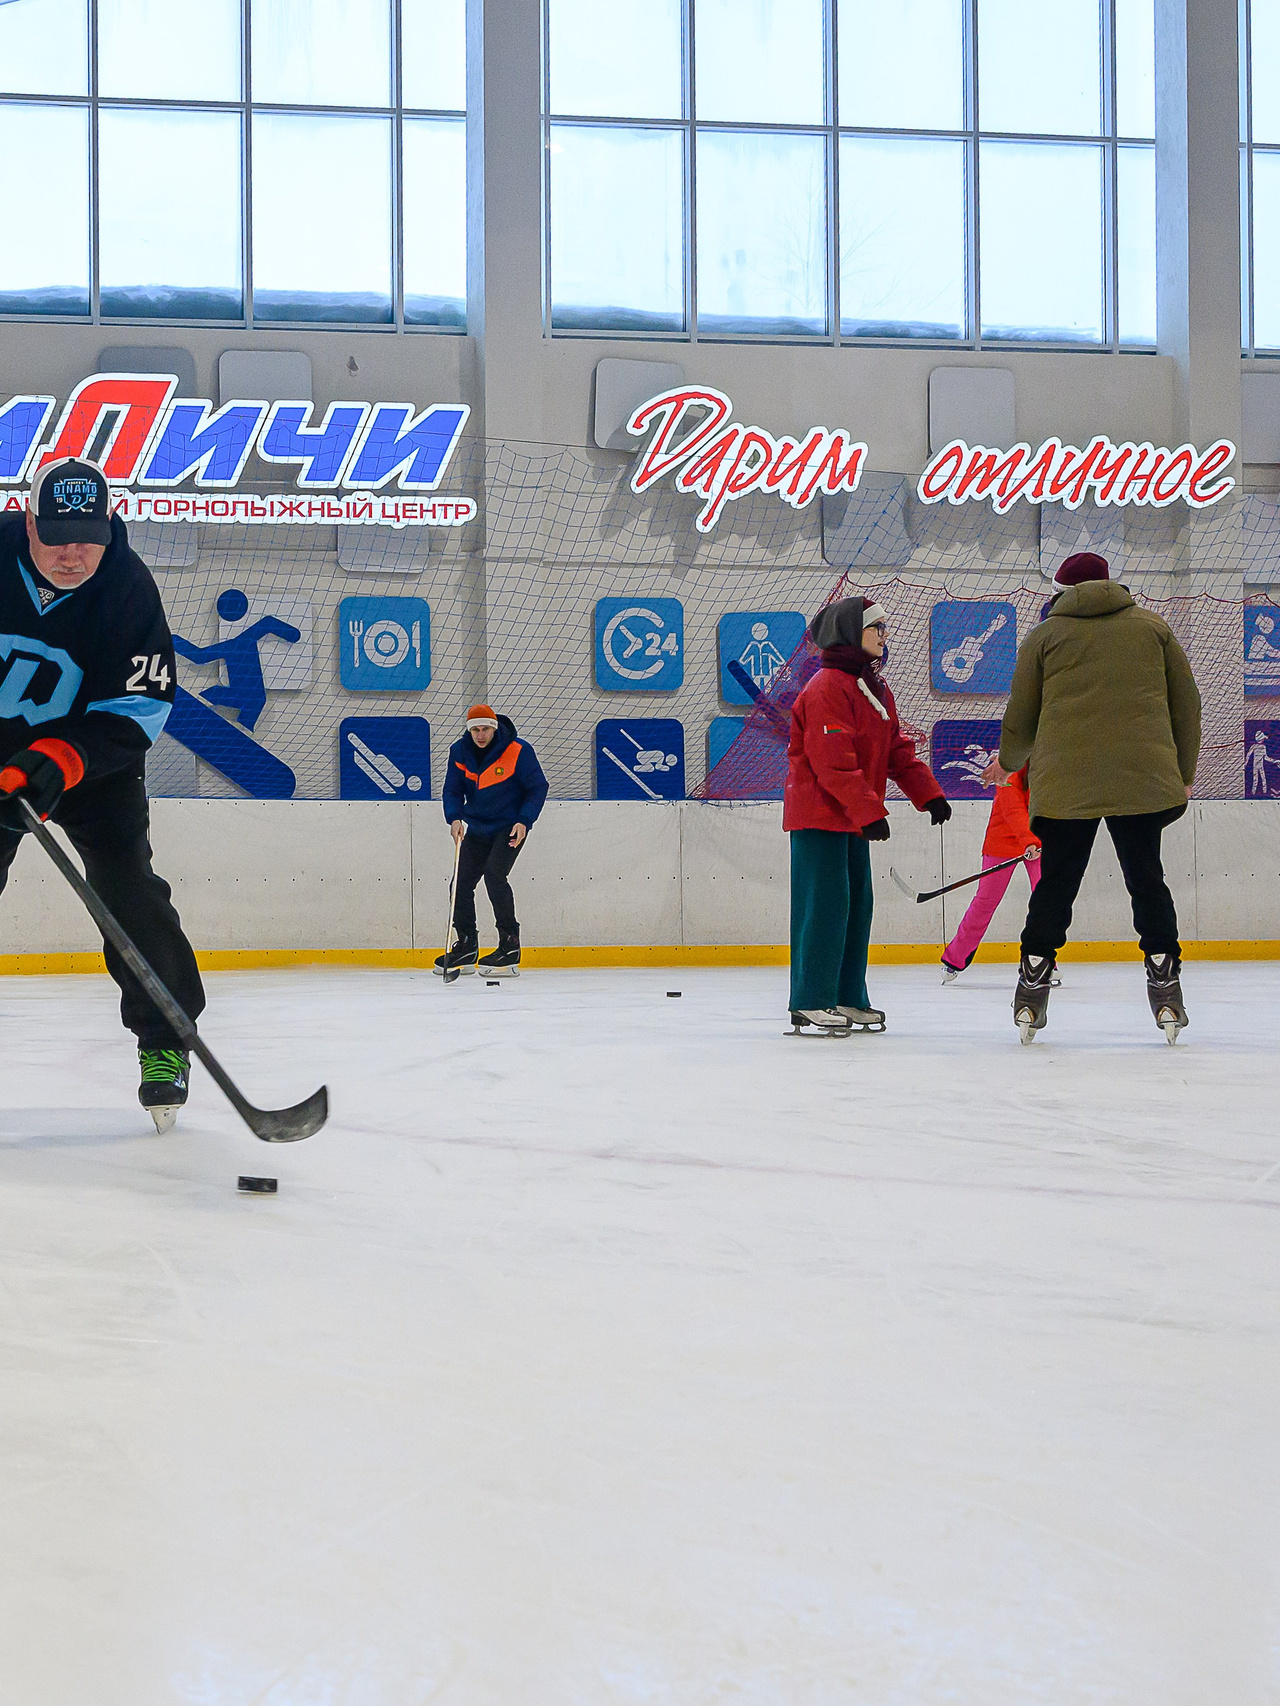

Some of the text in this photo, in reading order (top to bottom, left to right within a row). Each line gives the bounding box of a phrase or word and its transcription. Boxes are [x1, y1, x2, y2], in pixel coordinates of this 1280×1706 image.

[631, 389, 1233, 528] Дарим отличное
[53, 484, 97, 494] DINAMO
[137, 497, 373, 519] ГОРНОЛЫЖНЫЙ
[381, 501, 471, 522] ЦЕНТР
[644, 632, 679, 656] 24
[125, 653, 171, 692] 24
